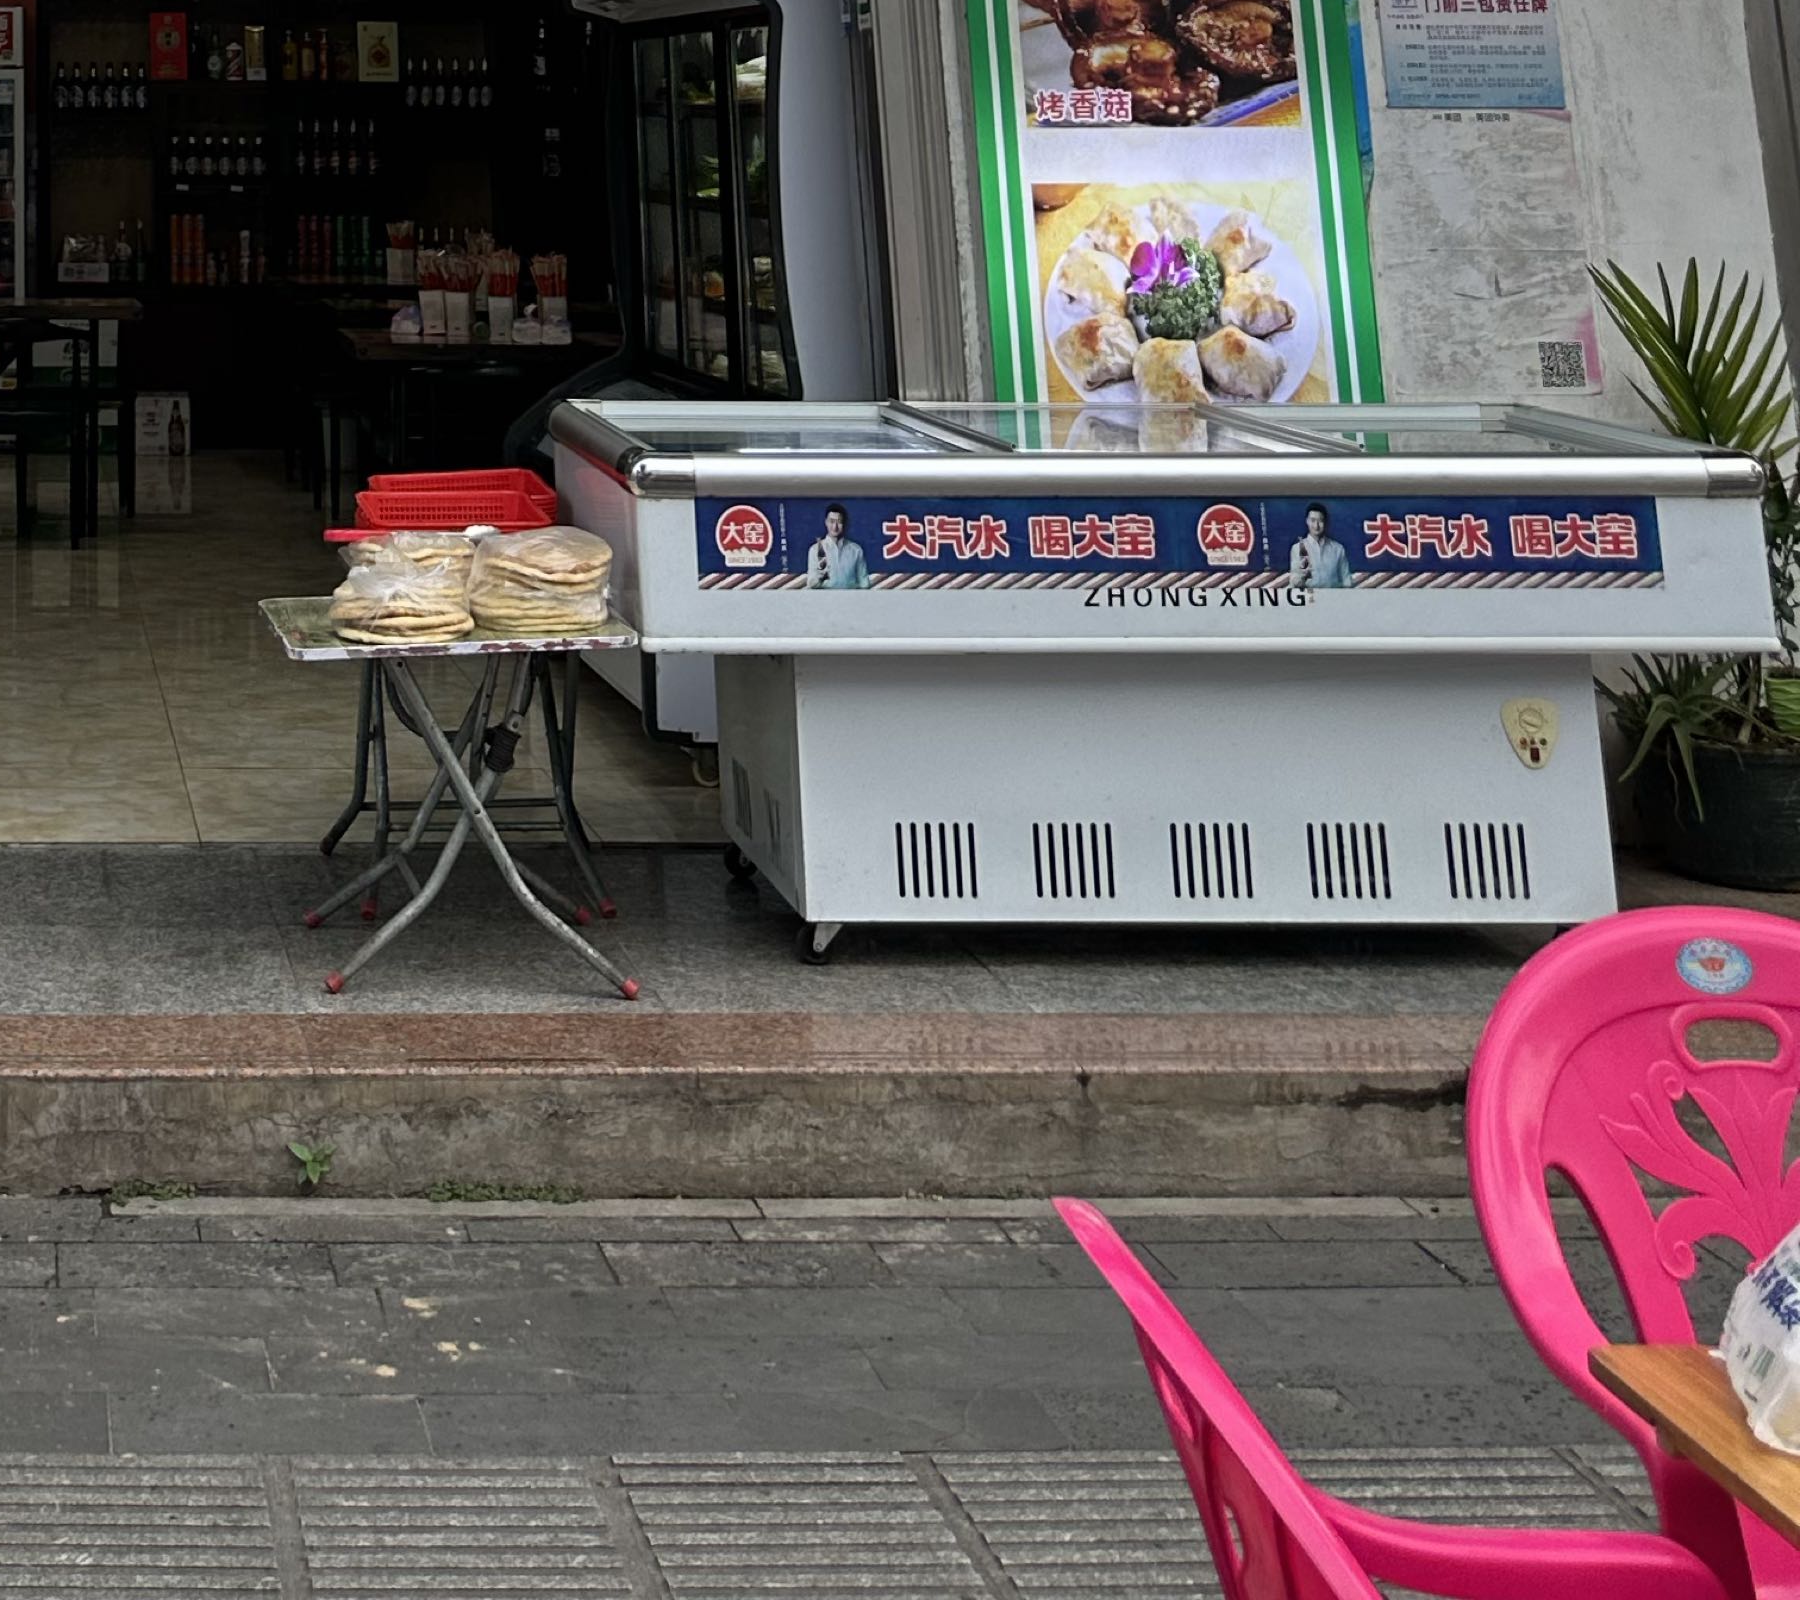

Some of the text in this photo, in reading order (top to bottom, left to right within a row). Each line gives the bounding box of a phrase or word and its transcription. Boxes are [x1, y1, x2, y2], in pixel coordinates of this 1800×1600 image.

[1034, 88, 1133, 122] 烤香菇
[722, 521, 765, 545] 大窑
[883, 514, 1156, 560] 大汽水 喝大窑
[1203, 520, 1246, 544] 大窑
[1363, 512, 1639, 560] 大汽水 喝大窑
